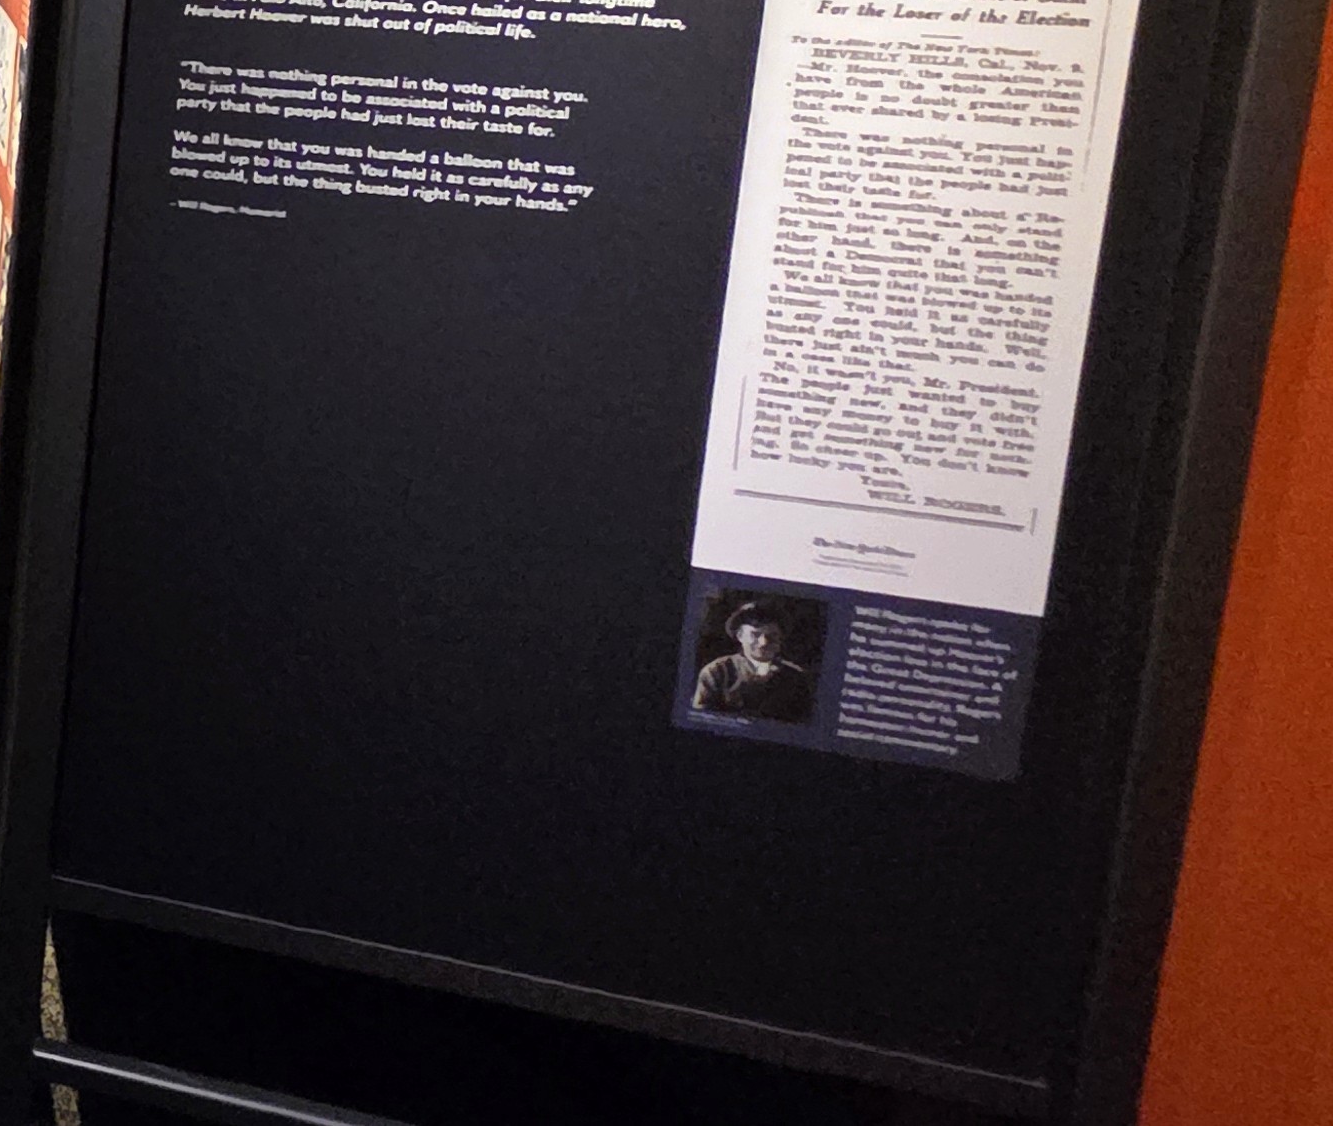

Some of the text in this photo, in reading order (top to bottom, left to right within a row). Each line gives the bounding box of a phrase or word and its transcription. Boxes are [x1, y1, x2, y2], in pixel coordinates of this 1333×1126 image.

[184, 4, 535, 40] Herbert Hoover was shut out of political life.
[422, 0, 467, 15] Once
[471, 3, 523, 18] hailed
[526, 10, 546, 20] as
[550, 12, 562, 21] a
[566, 11, 638, 25] national
[817, 0, 1090, 27] For the Loser of the Election
[179, 78, 570, 119] You just happened to be associated with a political
[237, 69, 265, 78] was
[268, 69, 327, 86] nothing
[331, 75, 398, 88] personal
[402, 77, 417, 89] in
[422, 78, 448, 92] the
[453, 84, 488, 95] vote
[492, 85, 549, 100] against
[554, 92, 588, 103] you.
[177, 99, 554, 137] party that the people had just lost their taste for.
[174, 130, 575, 175] We all know that you was handed a balloon that was
[170, 167, 199, 178] one
[203, 169, 248, 184] could,
[253, 171, 278, 185] but
[283, 175, 308, 187] the
[313, 177, 352, 194] thing
[356, 180, 409, 196] busted
[413, 186, 450, 202] right
[455, 190, 470, 202] in
[475, 195, 512, 207] your
[172, 146, 226, 163] blowed
[230, 156, 250, 166] up
[254, 156, 270, 167] to
[273, 156, 292, 168] its
[360, 163, 388, 177] You
[392, 166, 426, 180] held
[430, 169, 442, 182] it
[446, 174, 464, 184] as
[468, 175, 537, 193] carefully
[541, 182, 559, 192] as
[563, 185, 593, 198] any
